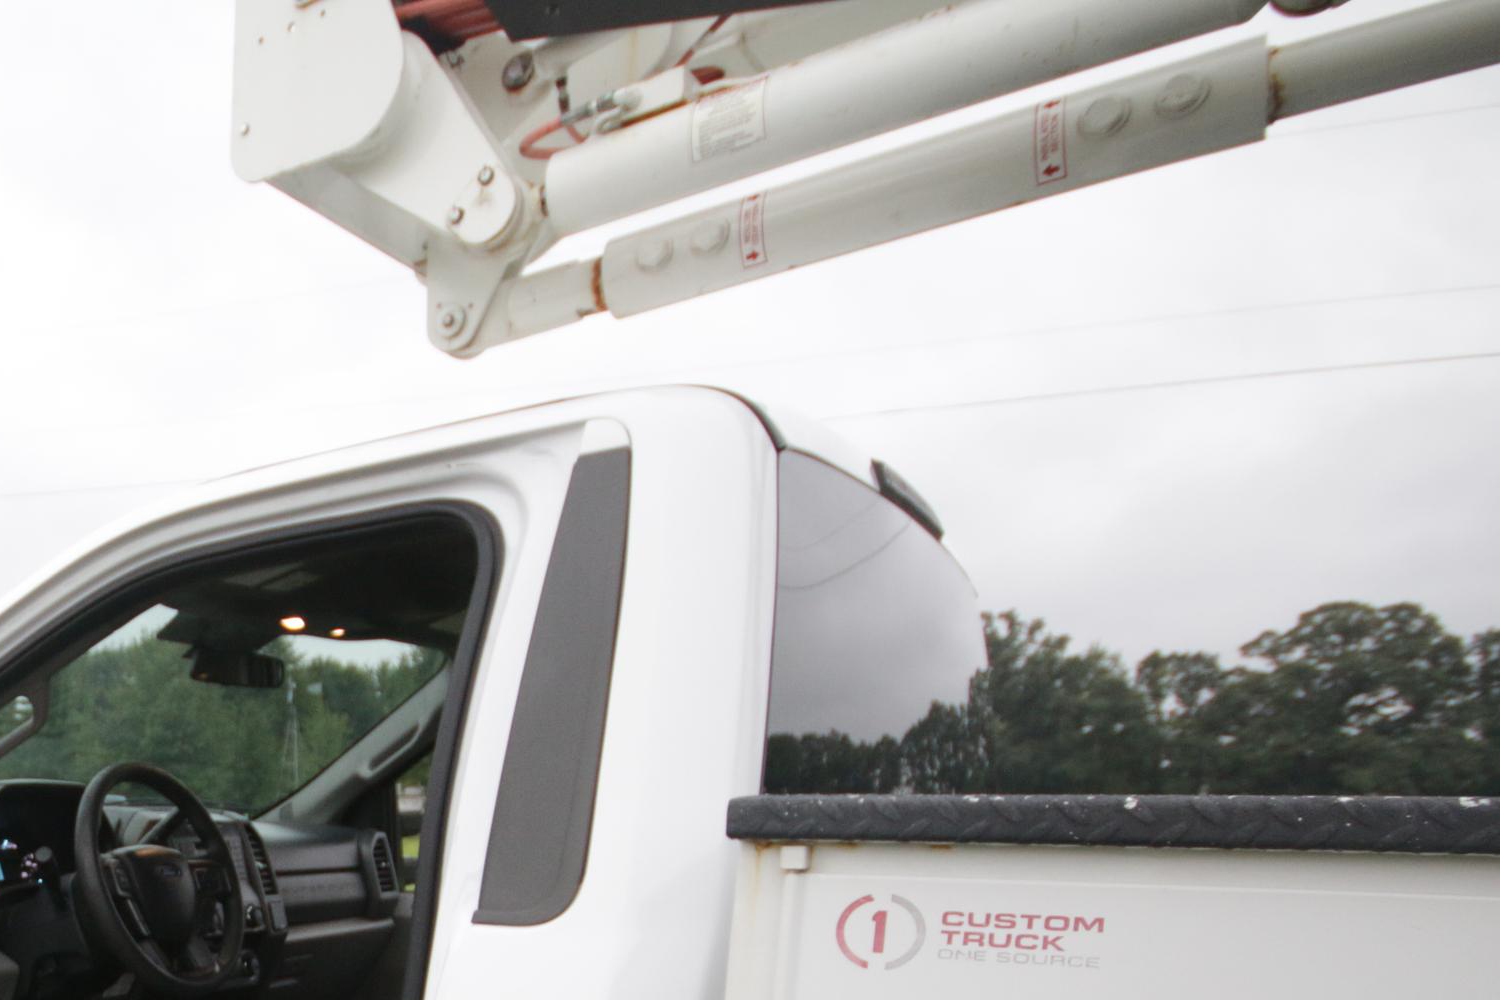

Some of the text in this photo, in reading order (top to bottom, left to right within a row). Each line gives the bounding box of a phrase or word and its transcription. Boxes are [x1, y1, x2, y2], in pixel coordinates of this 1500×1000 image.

[941, 910, 1105, 933] CUSTOM
[940, 930, 1065, 951] TRUCK
[937, 948, 1101, 969] ONE SOURCE
